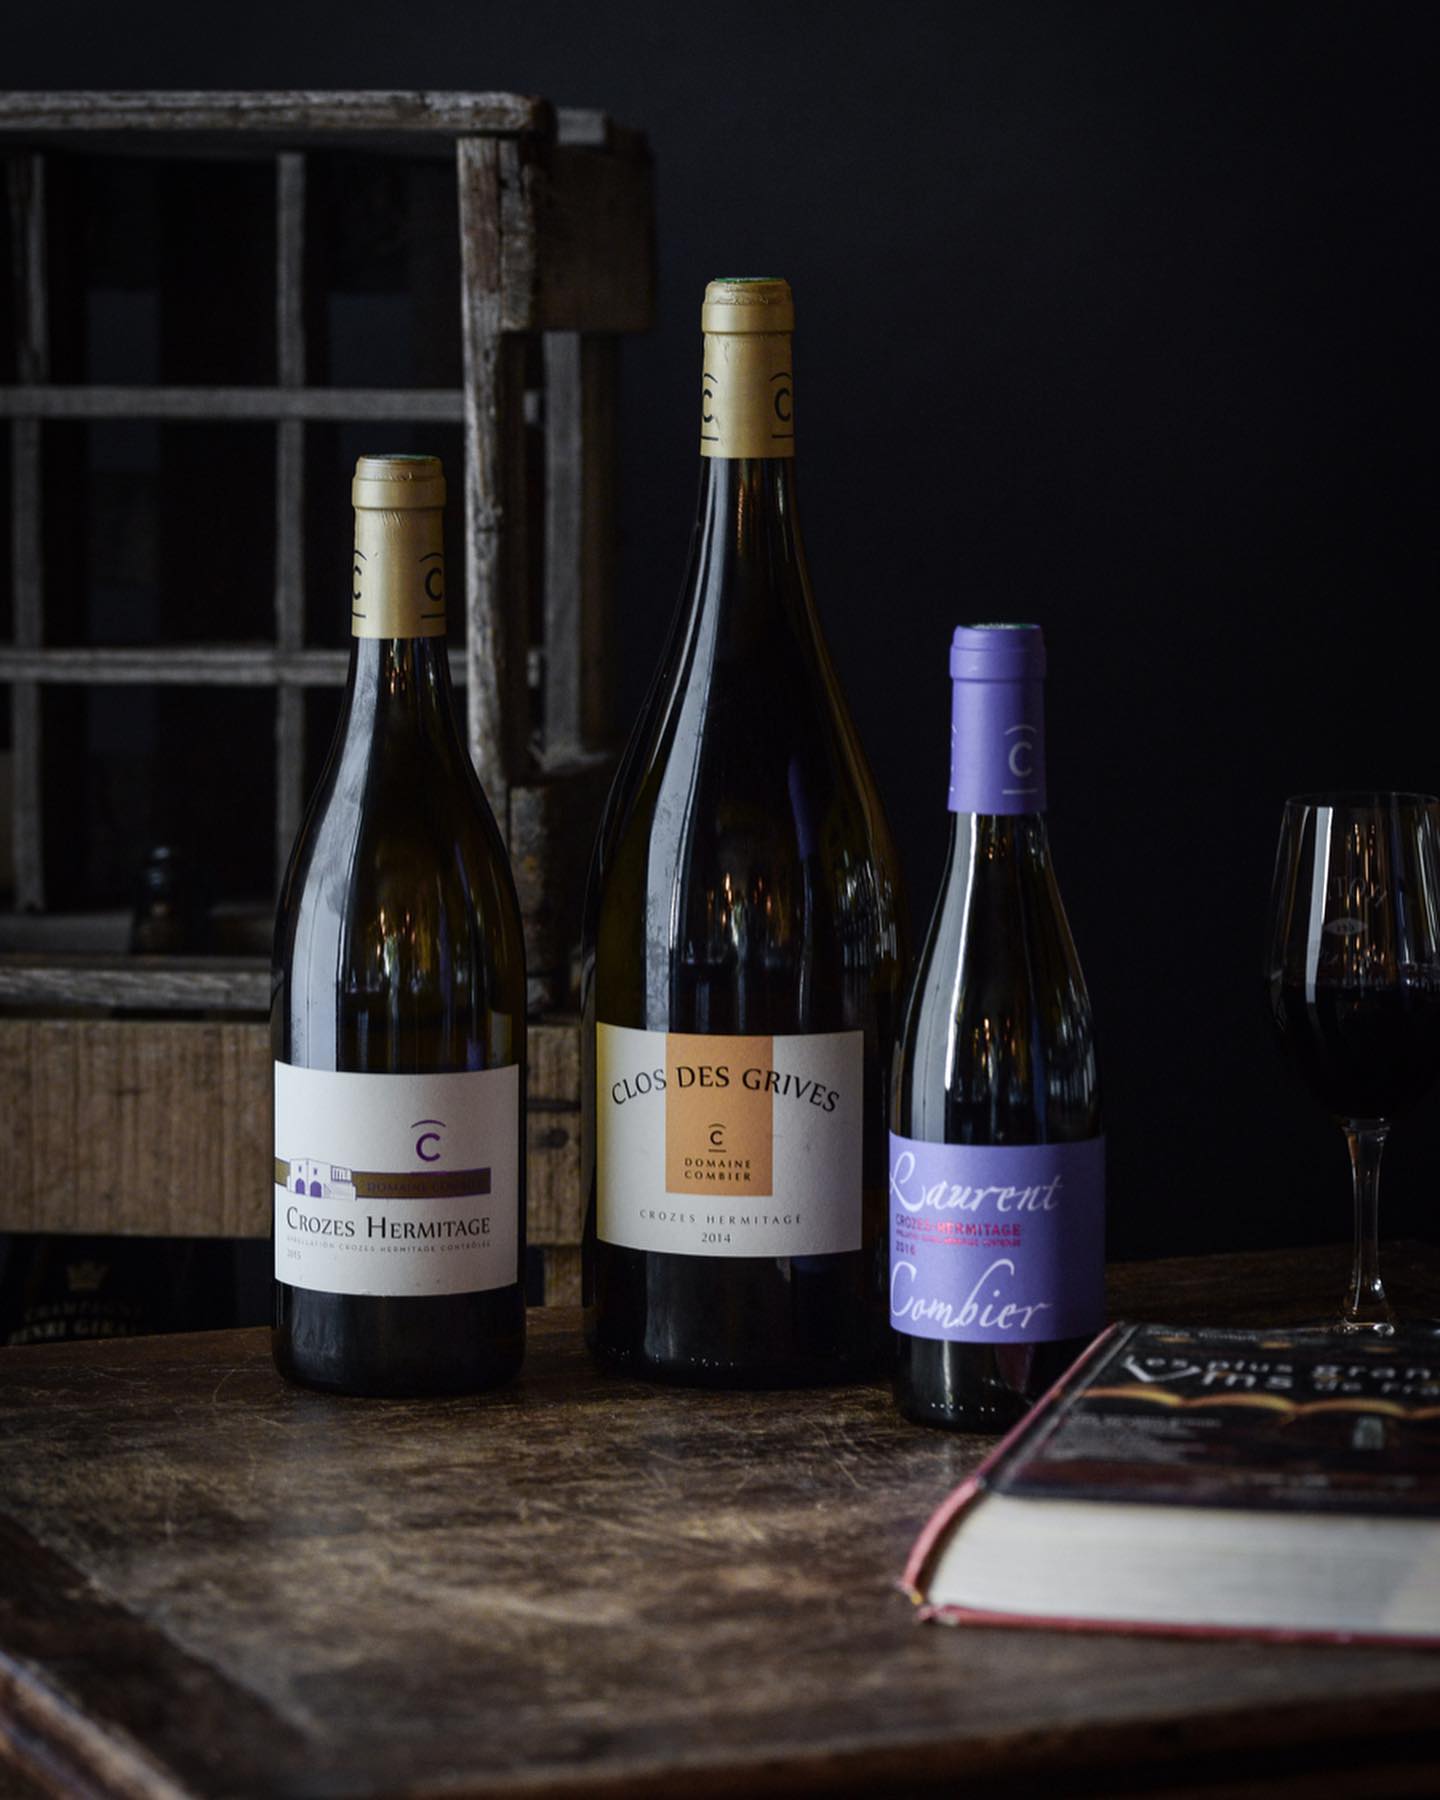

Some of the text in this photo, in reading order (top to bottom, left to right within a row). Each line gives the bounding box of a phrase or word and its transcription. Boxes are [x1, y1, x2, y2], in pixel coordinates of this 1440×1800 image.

[1007, 740, 1033, 777] C
[611, 1065, 840, 1113] CLOS DES GRIVES
[415, 1131, 441, 1163] C
[684, 1157, 752, 1170] DOMAINE
[684, 1171, 752, 1182] COMBIER
[889, 1151, 1064, 1213] Laurent
[286, 1206, 491, 1240] CROZES HERMITAGE
[639, 1209, 803, 1226] CROZES HERMITAGE
[338, 1242, 376, 1253] CROZES
[379, 1242, 436, 1254] HERMITAGE
[701, 1232, 731, 1245] 2014
[890, 1258, 1054, 1330] Combier
